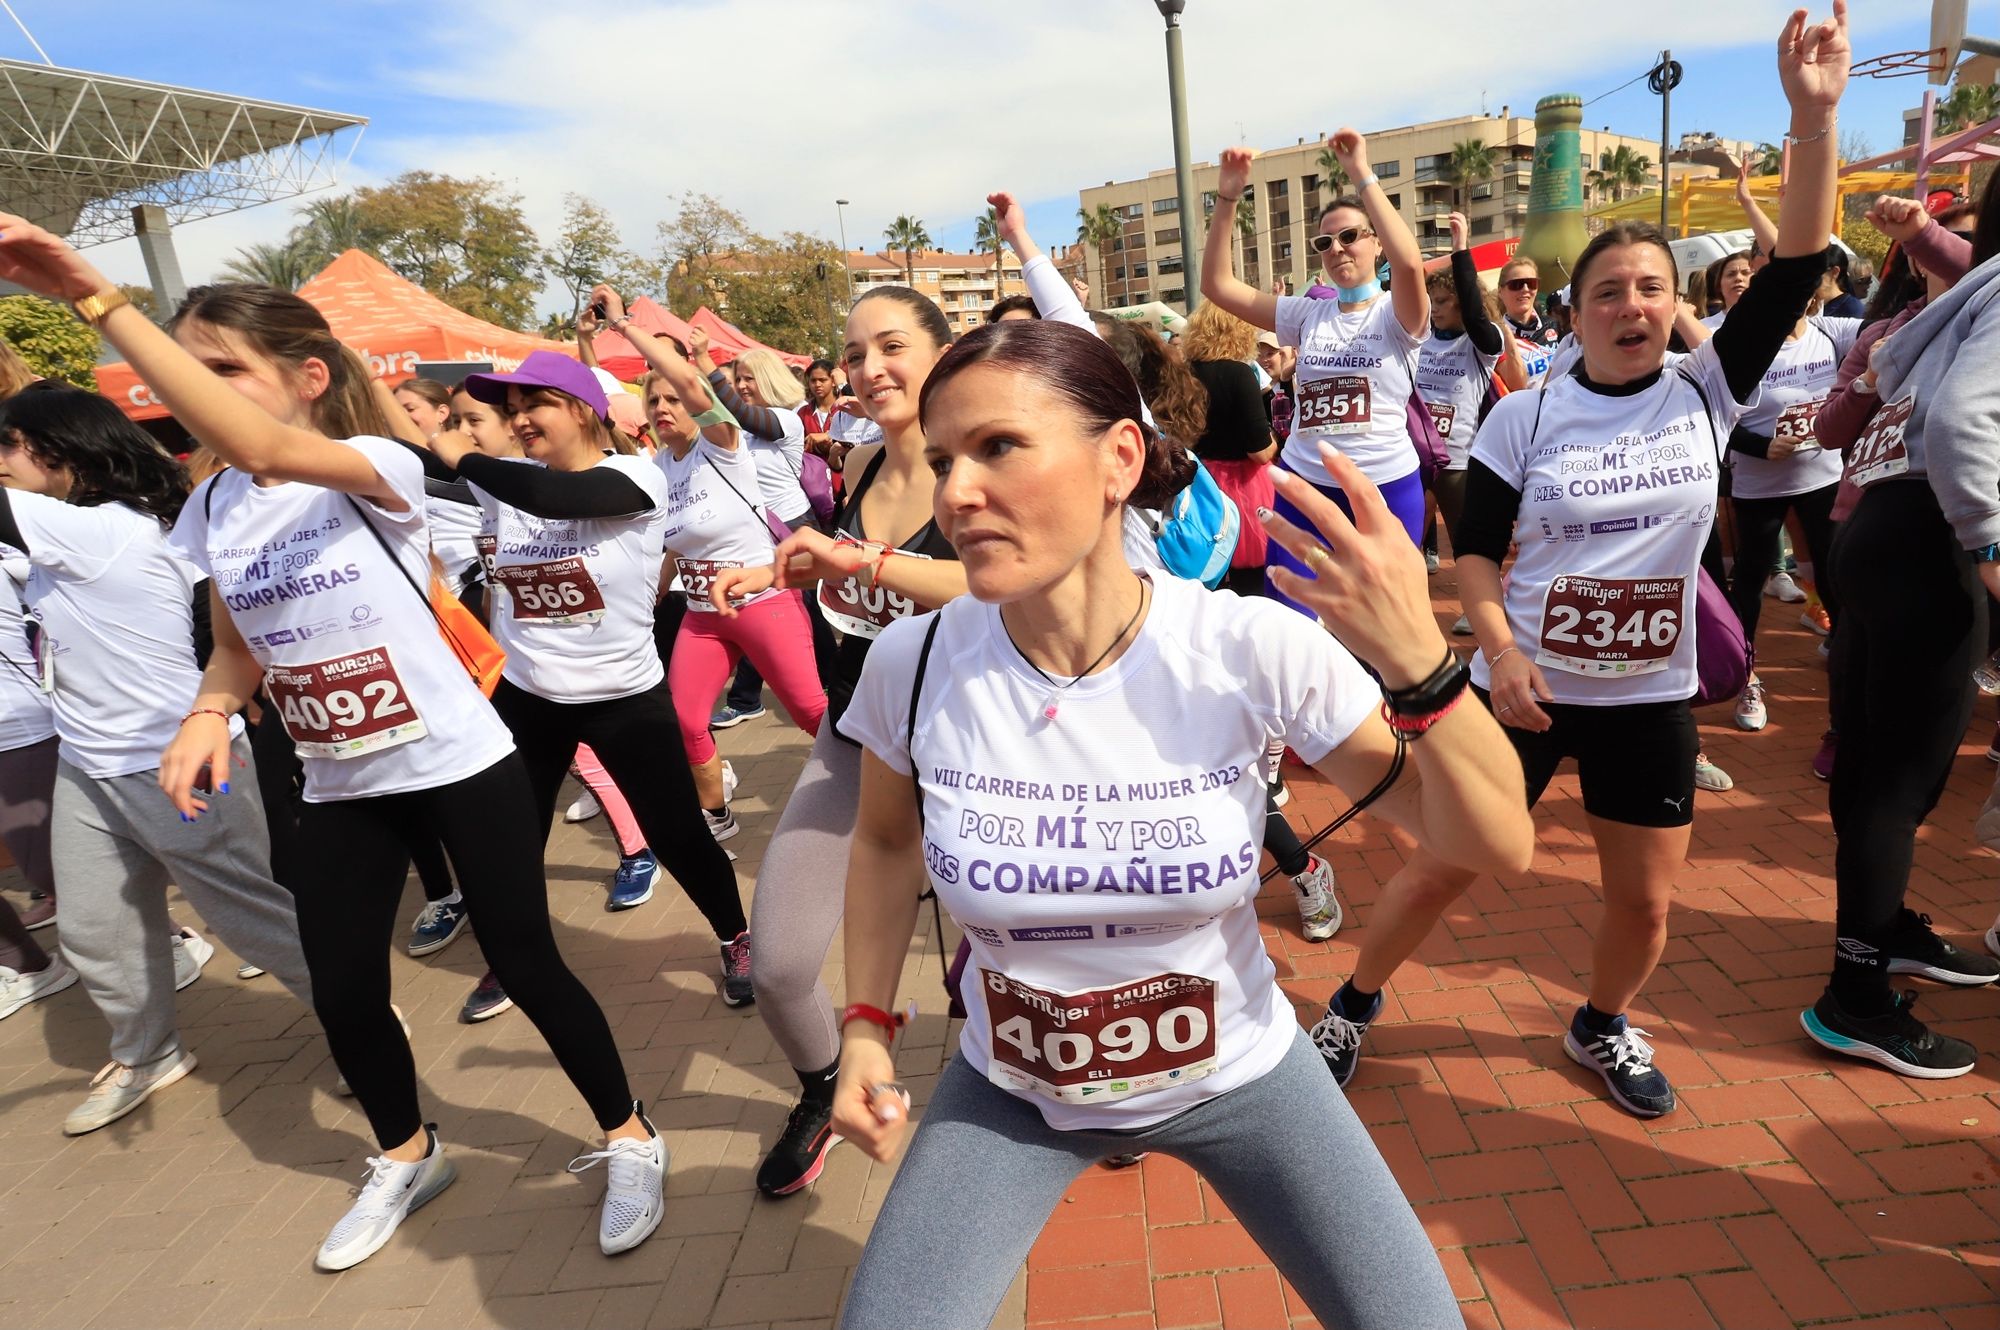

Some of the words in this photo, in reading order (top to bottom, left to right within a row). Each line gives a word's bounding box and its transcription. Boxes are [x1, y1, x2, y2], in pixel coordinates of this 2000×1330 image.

[1304, 354, 1382, 369] COMPAÑERAS
[1804, 356, 1831, 374] igual
[1301, 393, 1365, 421] 3551
[1432, 416, 1450, 433] 8
[1616, 436, 1629, 446] DE
[1632, 436, 1642, 446] LA
[1645, 425, 1681, 444] MUJER
[1561, 457, 1598, 474] POR
[1602, 447, 1628, 470] MÍ
[1631, 453, 1645, 465] Y
[1648, 443, 1690, 464] POR
[1534, 484, 1564, 502] MIS
[1568, 462, 1712, 497] COMPAÑERAS
[274, 540, 286, 552] LA
[502, 542, 600, 559] COMPAÑERAS
[245, 554, 270, 582] MÍ
[282, 548, 321, 573] POR
[510, 569, 538, 582] mujer
[543, 560, 580, 573] MURCIA
[226, 563, 361, 612] COMPAÑERAS
[516, 581, 585, 610] 566
[682, 574, 717, 596] 22
[1571, 578, 1600, 588] carrera
[1634, 582, 1679, 594] MURCIA
[1577, 585, 1624, 606] mujer
[1545, 605, 1678, 648] 2346
[321, 652, 384, 676] MURCIA
[1597, 651, 1628, 660] MAR?A
[281, 672, 312, 692] mujer
[332, 673, 342, 681] DE
[343, 668, 368, 679] MARZO
[284, 679, 408, 731] 4092
[331, 732, 347, 741] ELI
[935, 767, 962, 788] VIII
[965, 773, 1055, 801] CARRERA
[1062, 784, 1088, 802] DE
[1096, 784, 1120, 802] LA
[1128, 778, 1196, 802] MUJER
[1200, 765, 1241, 792] 2023
[959, 809, 1026, 847] POR
[1036, 805, 1087, 849] MÍ
[1096, 821, 1124, 851] Y
[1131, 816, 1207, 850] POR
[925, 836, 959, 884] MIS
[968, 840, 1254, 895] COMPAÑERAS
[1837, 950, 1878, 966] umbro
[1122, 999, 1137, 1007] DE
[1139, 990, 1177, 1004] MARZO
[1179, 986, 1205, 995] 2023
[1023, 994, 1094, 1028] mujer
[996, 1006, 1209, 1072] 4090
[1088, 1069, 1112, 1079] ELI
